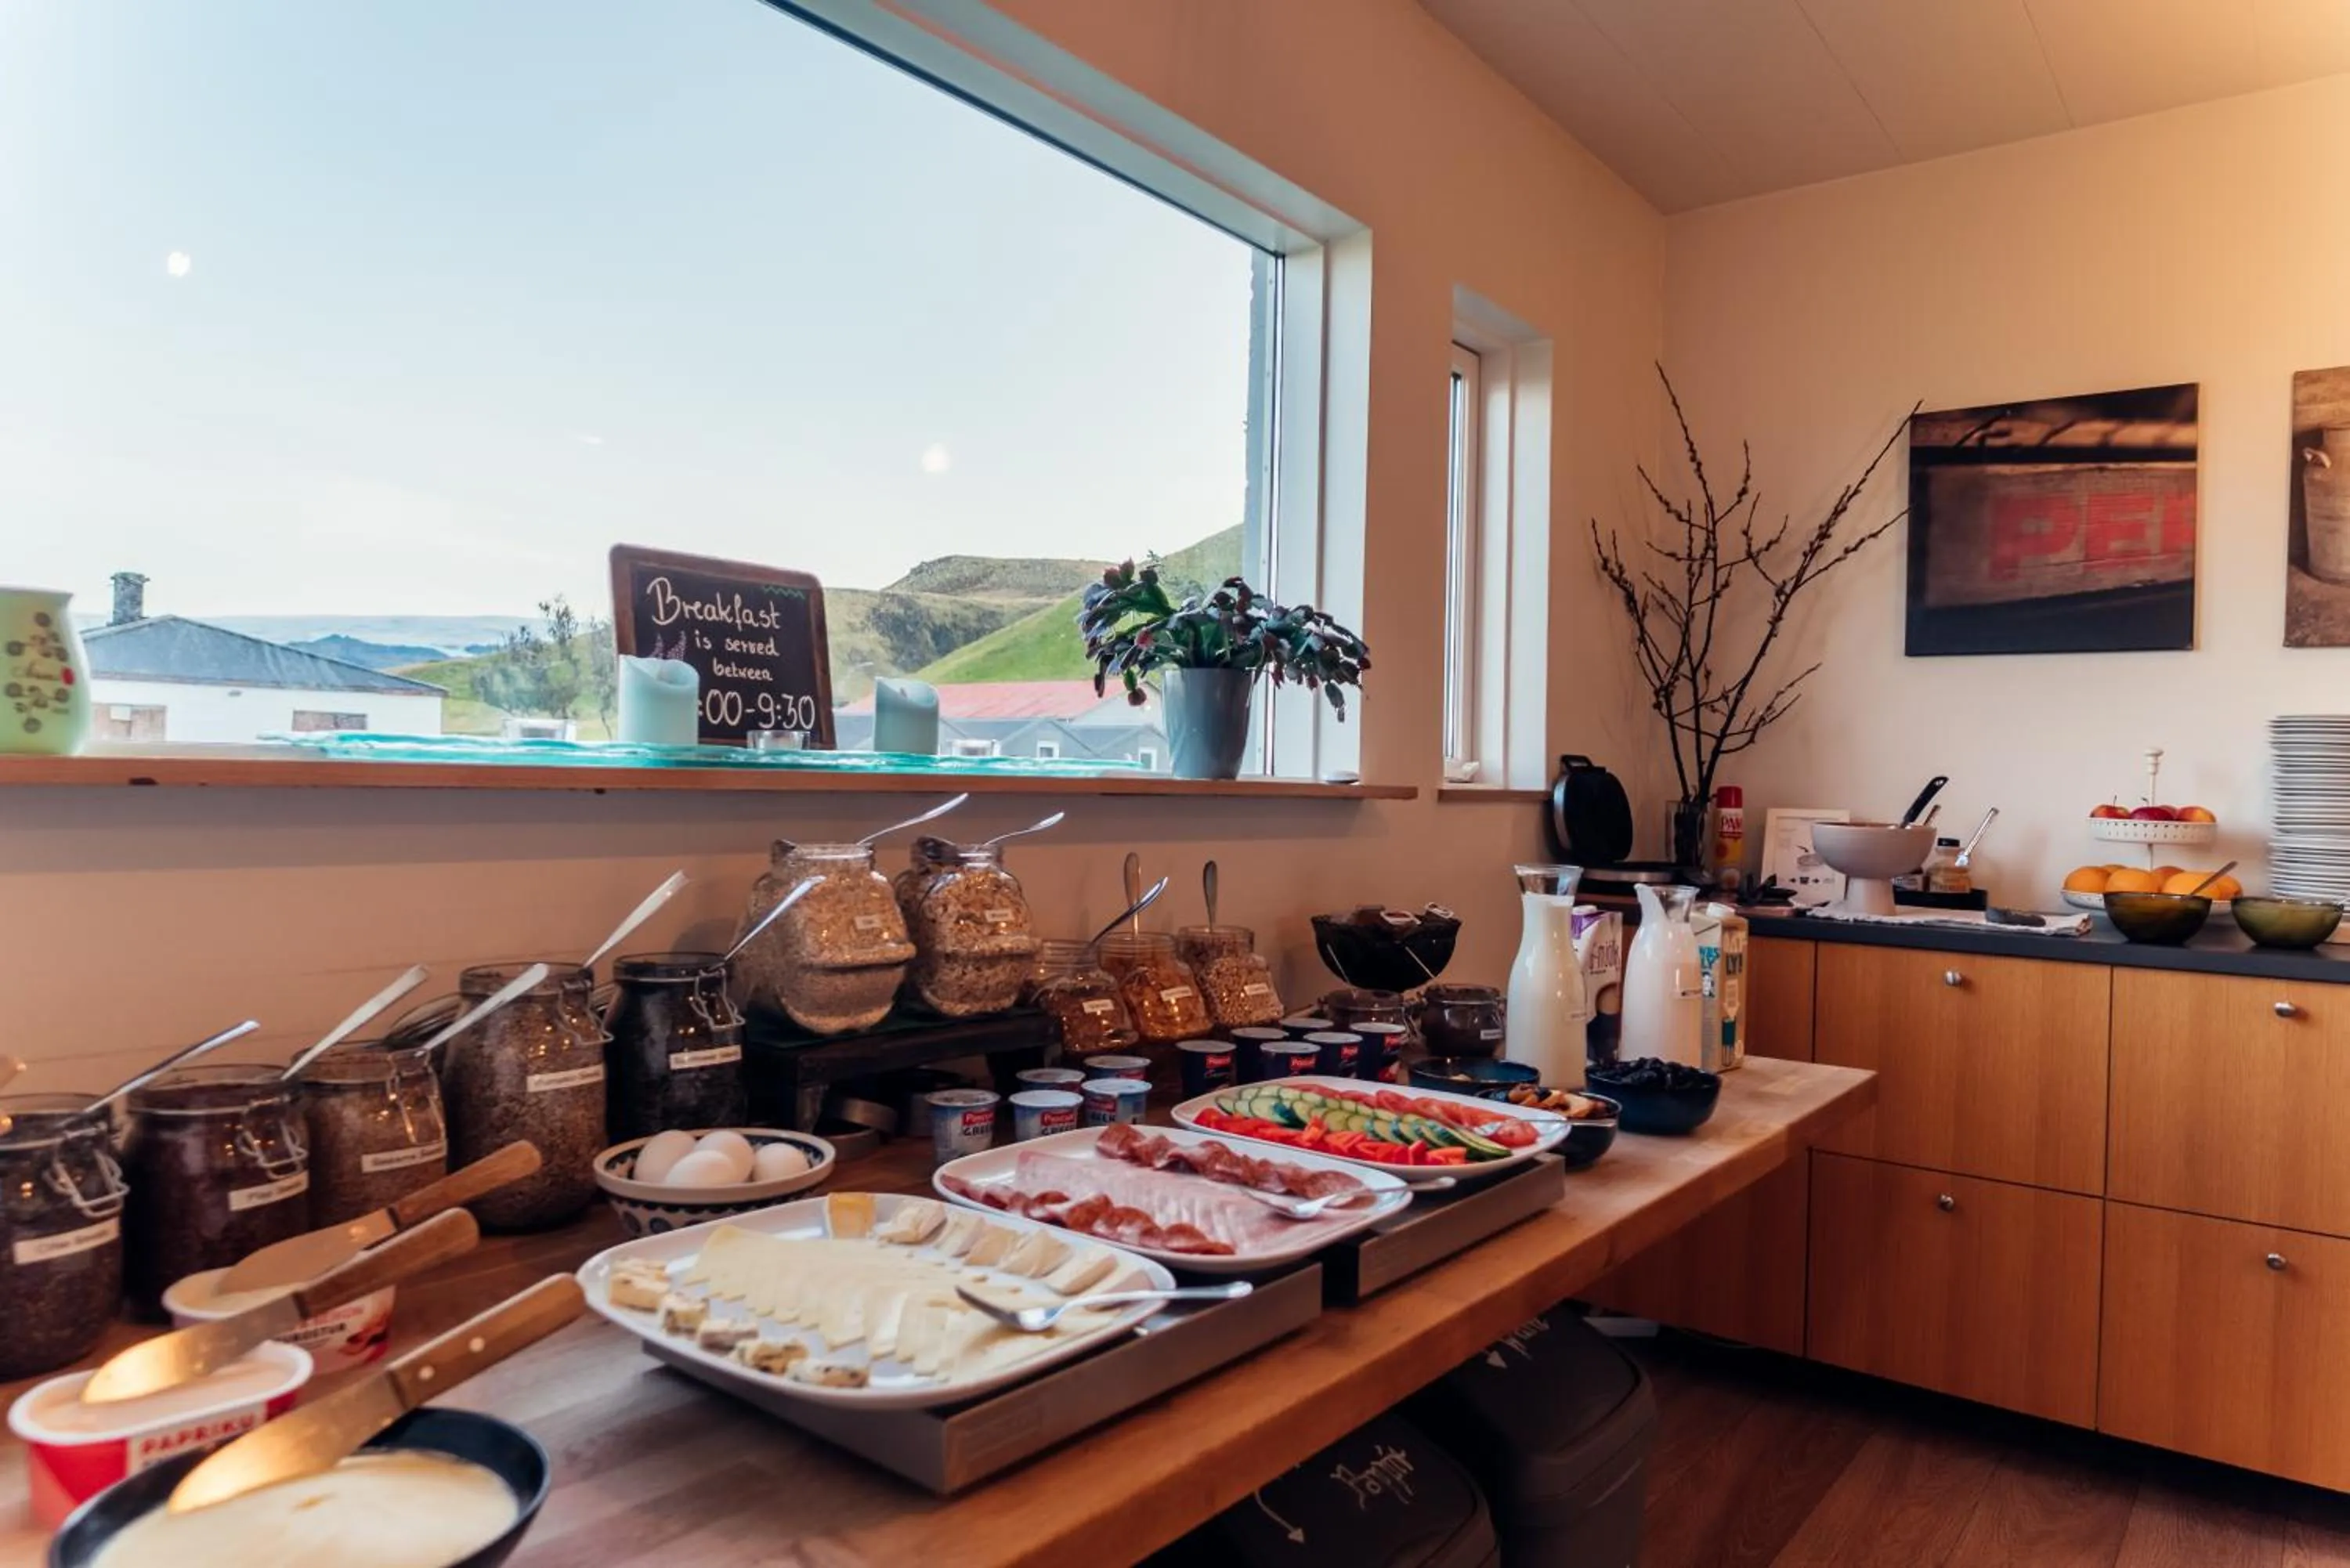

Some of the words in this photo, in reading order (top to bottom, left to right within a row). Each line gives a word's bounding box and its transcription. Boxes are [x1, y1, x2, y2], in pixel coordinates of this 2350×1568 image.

[646, 577, 781, 631] Breakfast
[694, 630, 712, 649] is
[725, 637, 780, 656] served
[712, 658, 774, 681] between
[696, 688, 815, 729] :00-9:30
